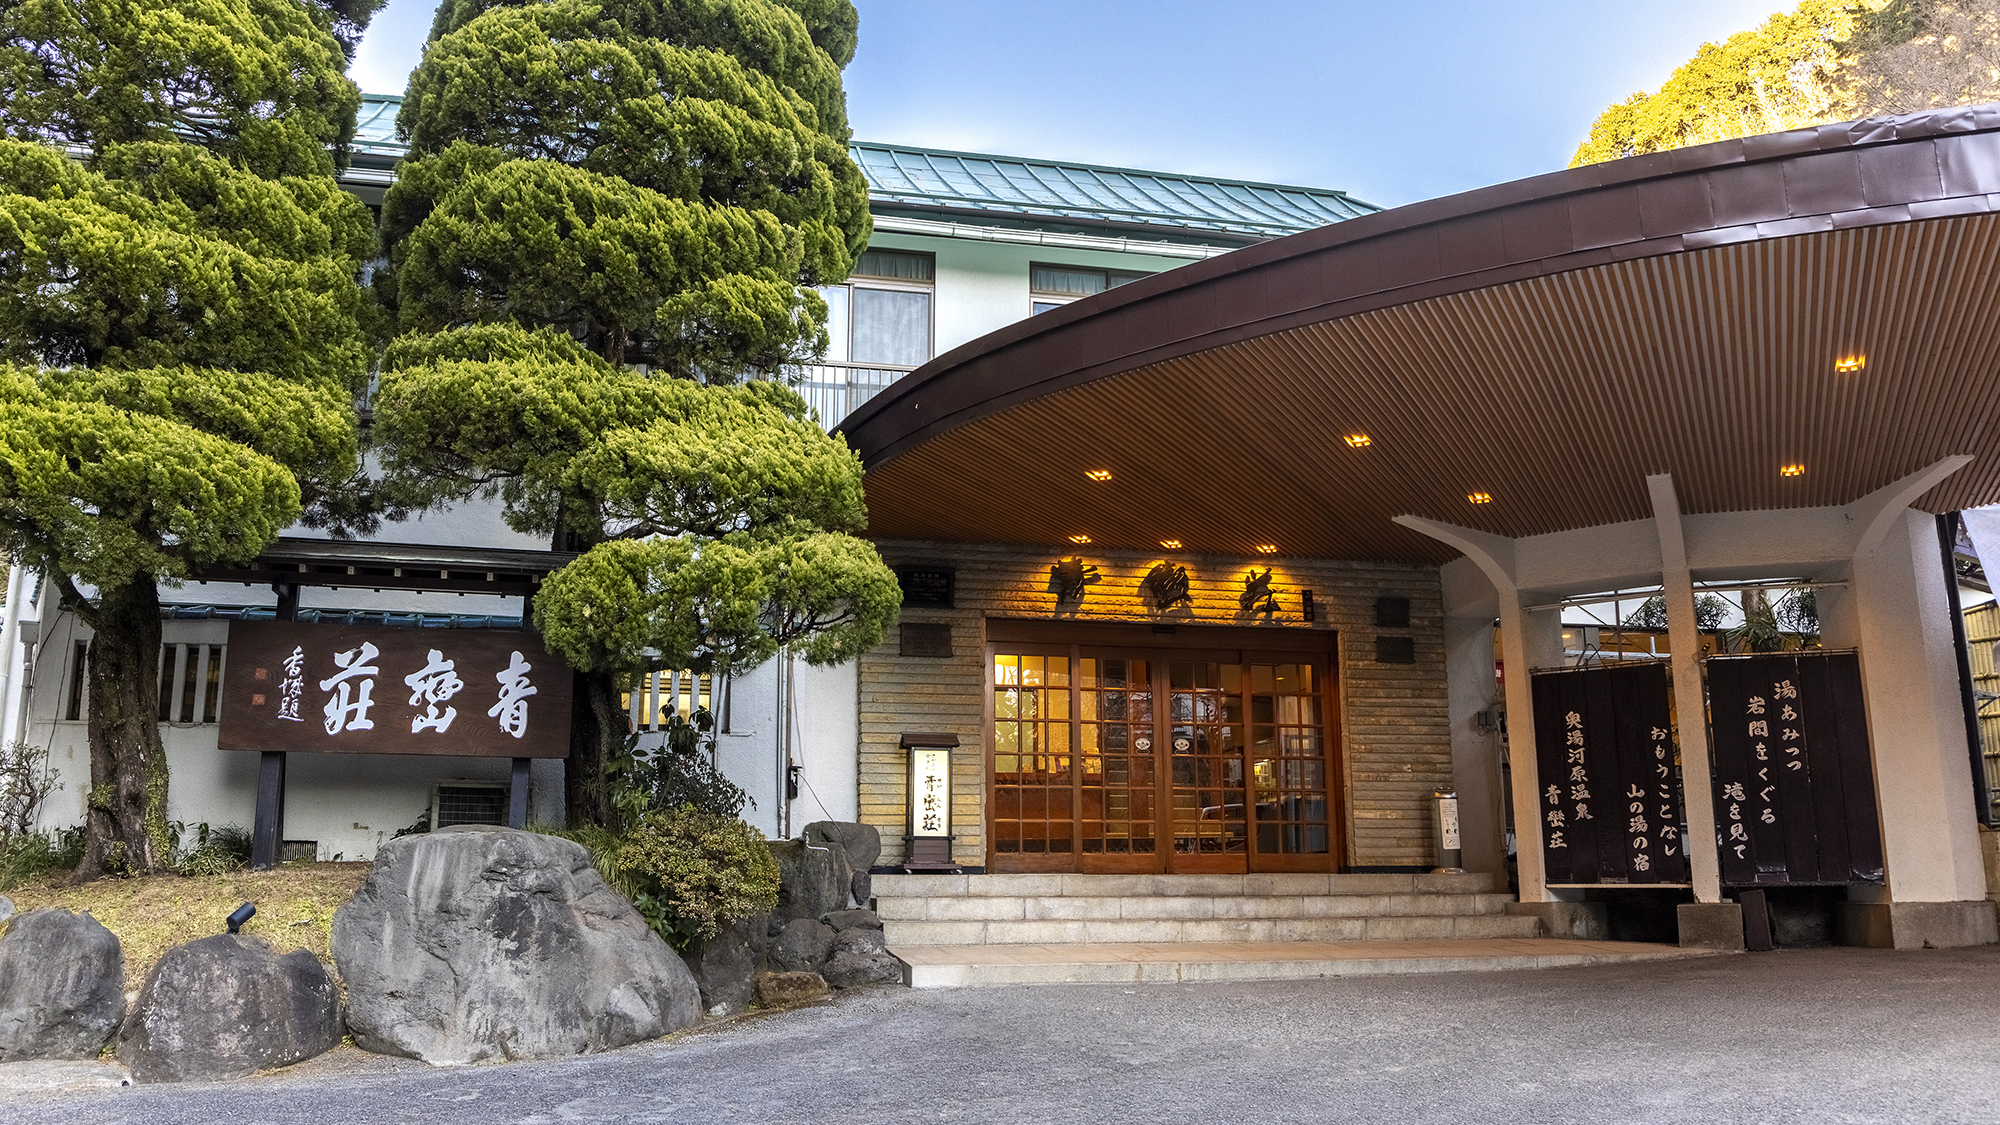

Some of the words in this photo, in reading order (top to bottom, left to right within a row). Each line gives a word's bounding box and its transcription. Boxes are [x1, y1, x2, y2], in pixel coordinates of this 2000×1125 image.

[1565, 710, 1594, 821] 奥湯河原温泉
[1746, 695, 1776, 824] 岩間をくぐる
[1773, 679, 1802, 771] 湯あみつつ
[1544, 784, 1568, 849] 青巒荘
[1626, 783, 1650, 872] 山の湯の宿
[1650, 726, 1678, 857] おもうことなし
[1722, 781, 1749, 860] 滝を見て
